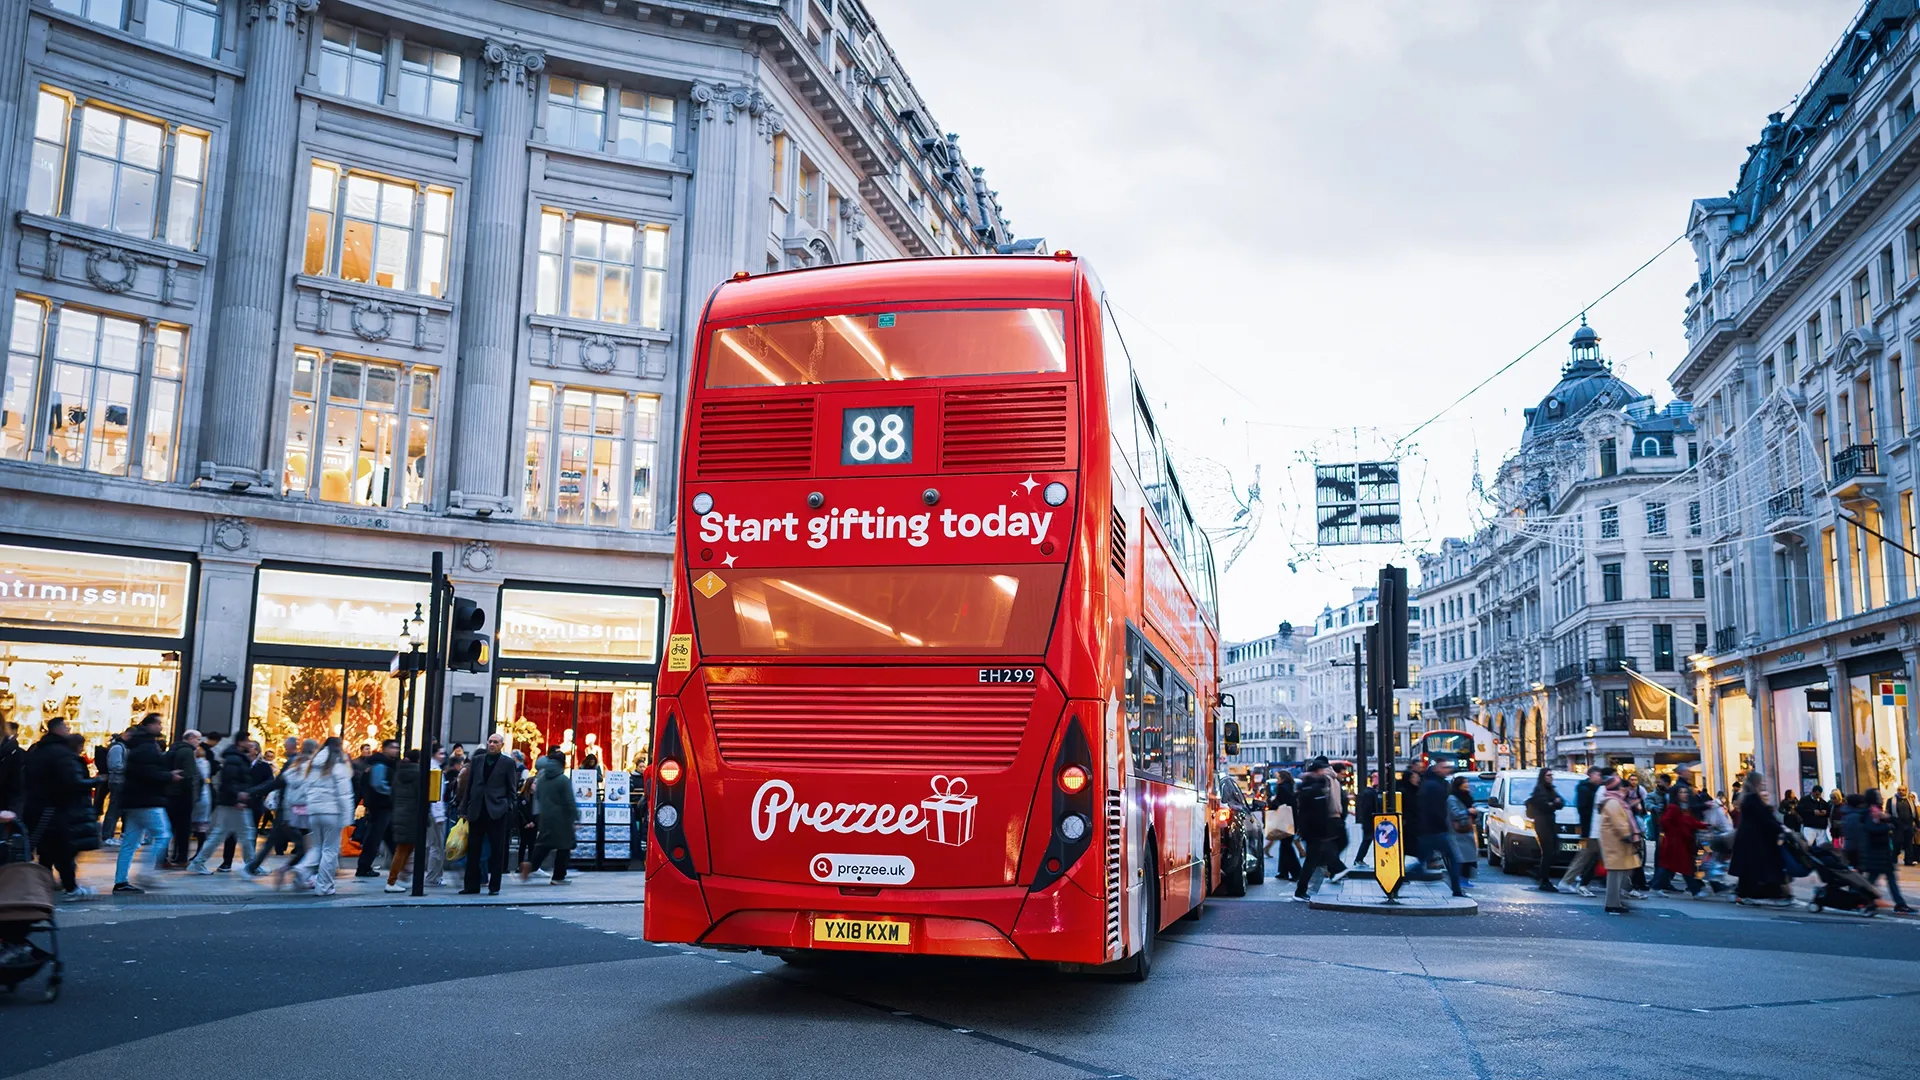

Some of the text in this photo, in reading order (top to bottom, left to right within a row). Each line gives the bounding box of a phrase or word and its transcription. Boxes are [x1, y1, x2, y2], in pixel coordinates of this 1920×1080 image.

[849, 414, 905, 461] 88
[699, 505, 1053, 549] Start gifting today
[979, 669, 1035, 683] EH299
[751, 779, 930, 841] Prezzee
[837, 864, 906, 877] prezzee.uk
[825, 921, 899, 941] YX18 KXM
